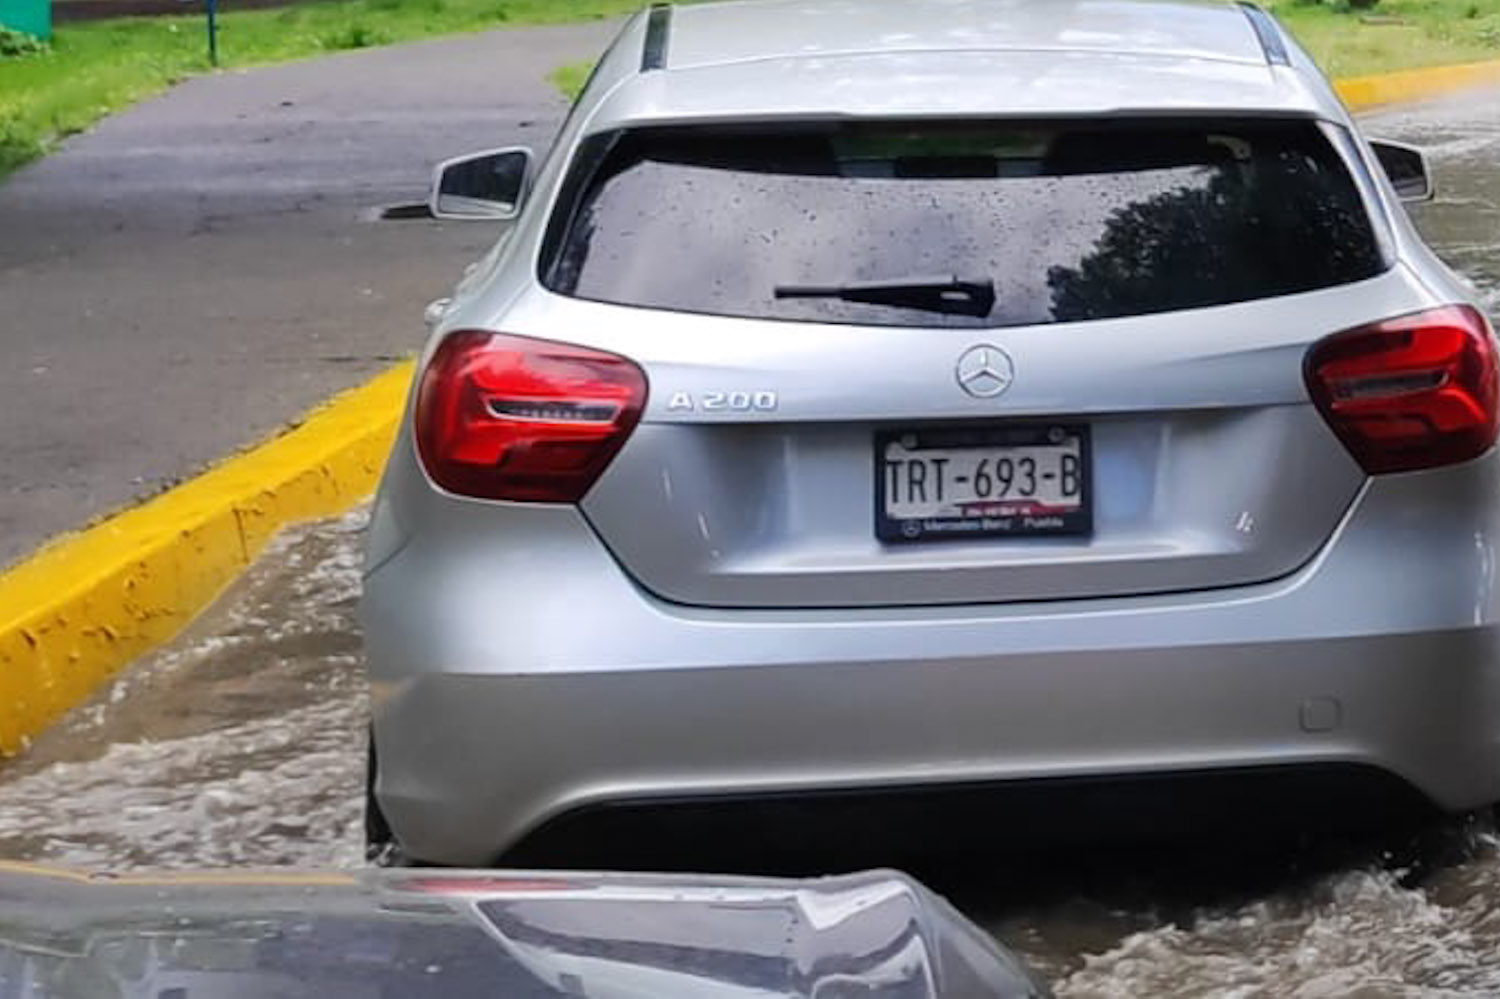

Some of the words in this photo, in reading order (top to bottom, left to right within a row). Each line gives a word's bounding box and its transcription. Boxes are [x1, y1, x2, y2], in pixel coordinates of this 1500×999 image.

[667, 391, 694, 410] A
[703, 391, 779, 411] 200
[886, 455, 1079, 503] TRT-693-B
